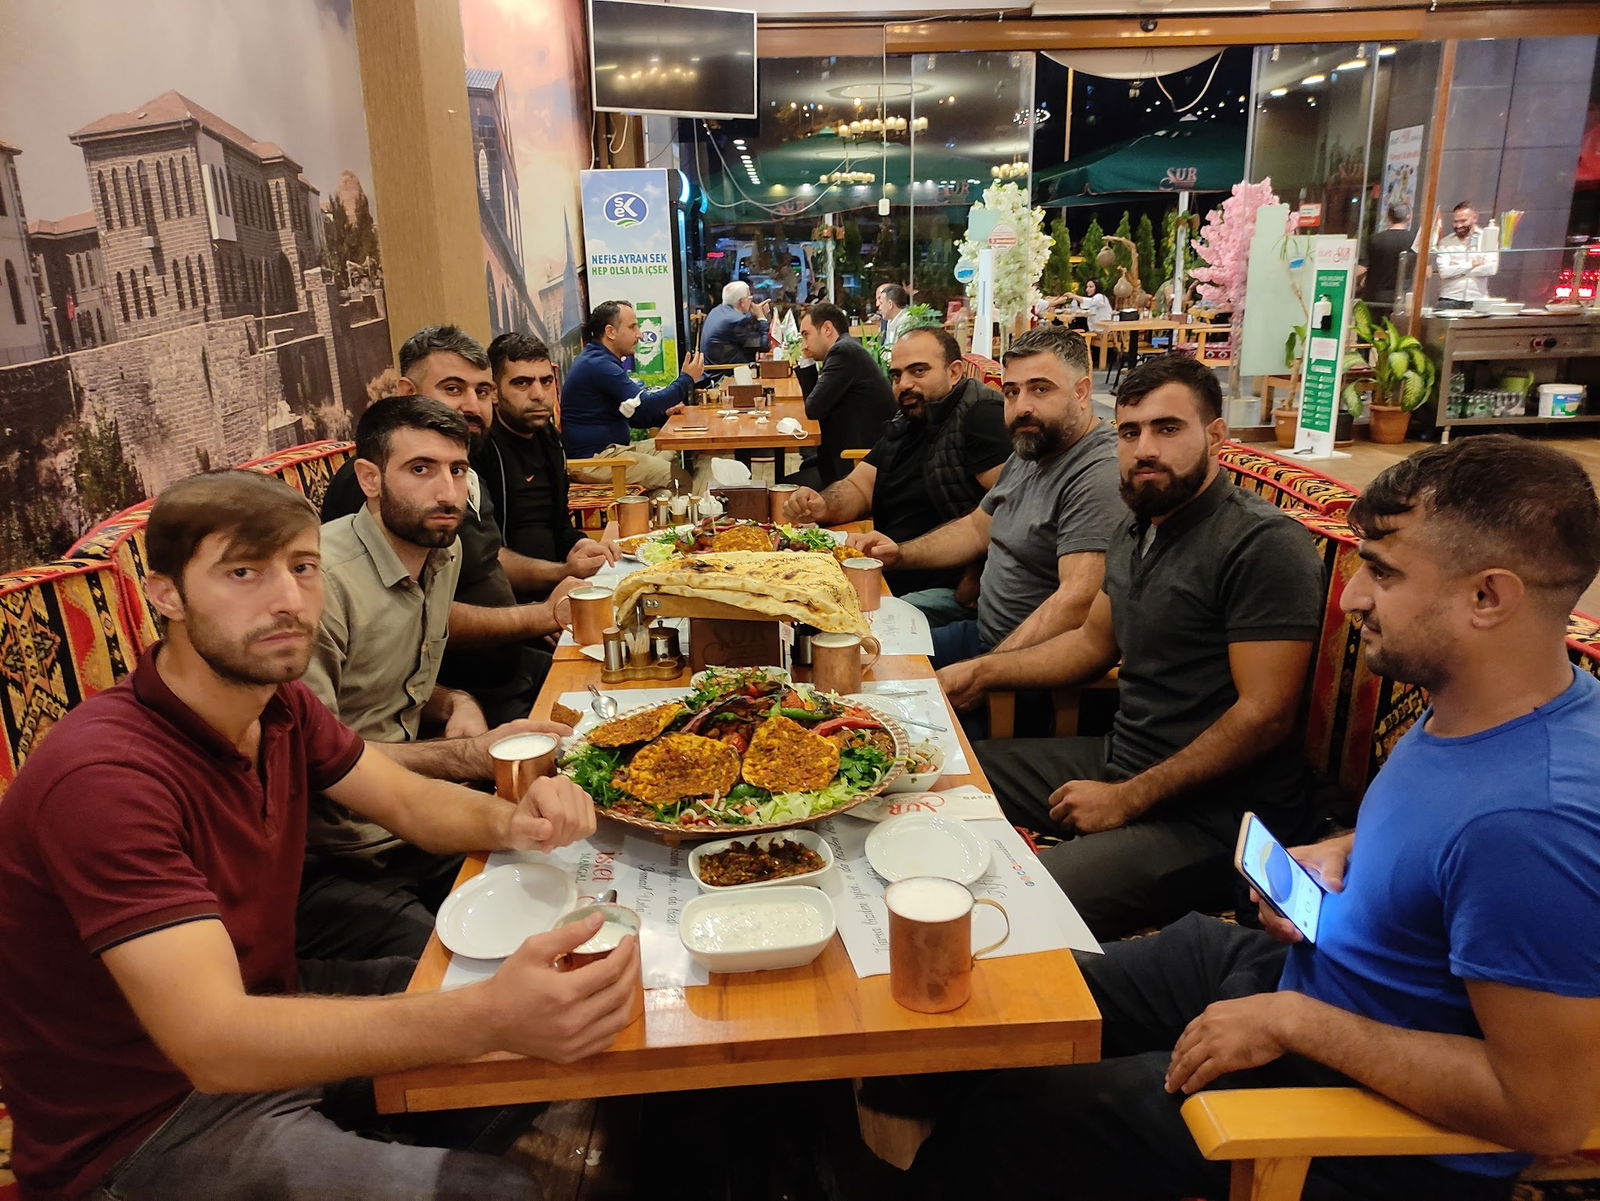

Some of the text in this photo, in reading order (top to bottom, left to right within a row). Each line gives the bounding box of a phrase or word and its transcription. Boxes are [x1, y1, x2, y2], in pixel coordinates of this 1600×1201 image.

[618, 253, 648, 264] AYRAN
[649, 253, 667, 263] SEK
[592, 266, 608, 275] HEP
[610, 266, 630, 275] OLSA
[632, 266, 644, 275] DA
[576, 853, 591, 884] MANGAL
